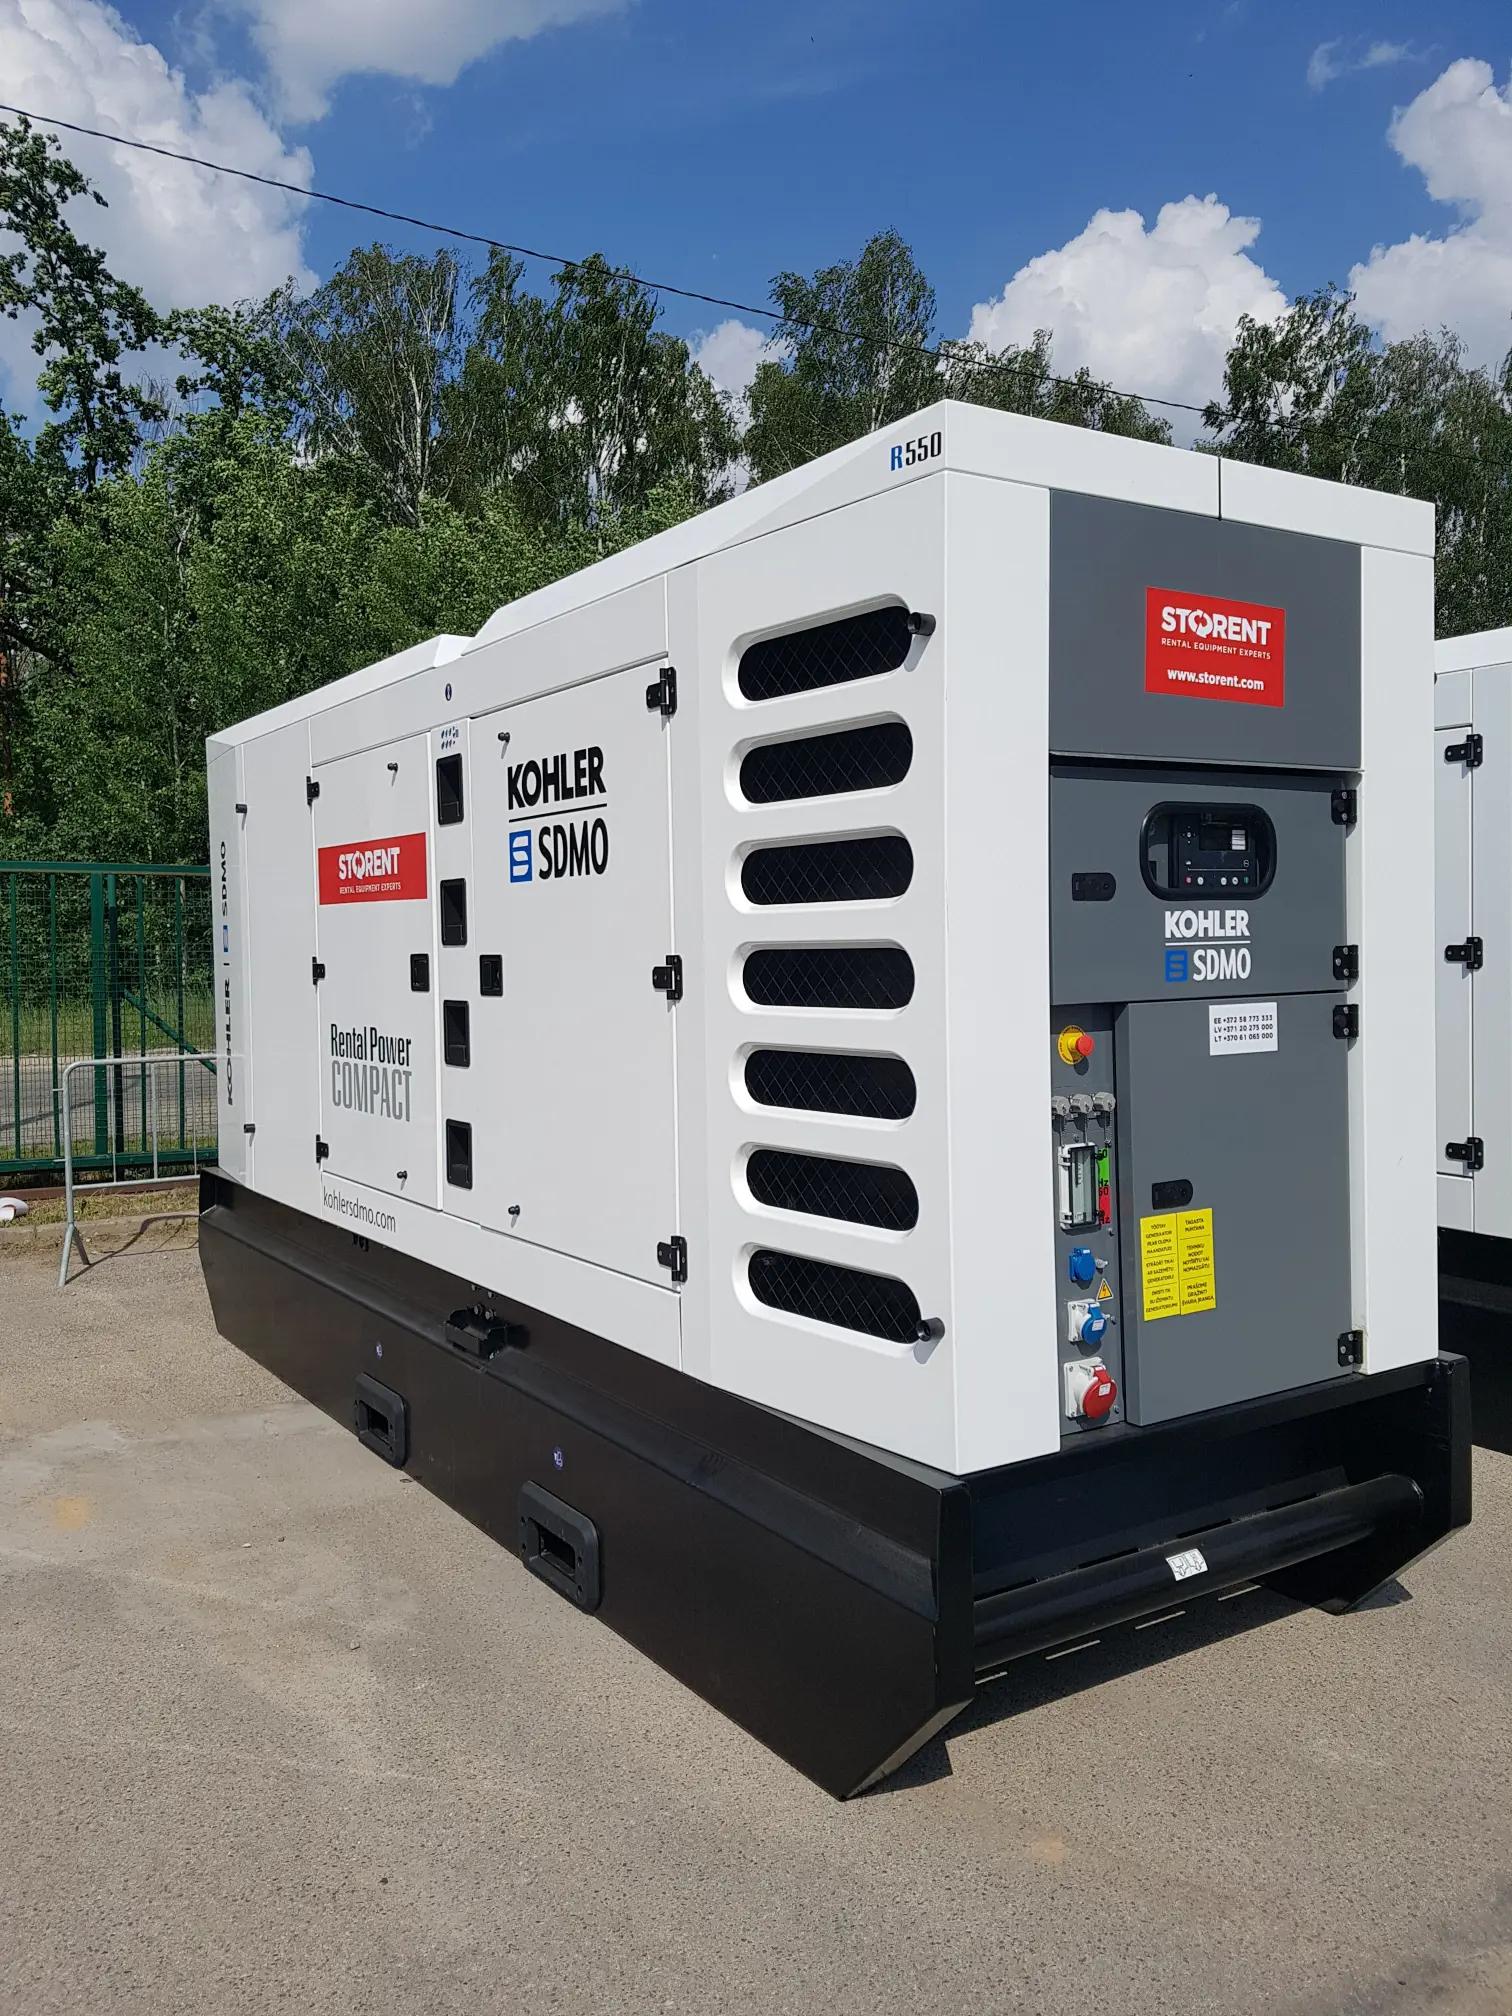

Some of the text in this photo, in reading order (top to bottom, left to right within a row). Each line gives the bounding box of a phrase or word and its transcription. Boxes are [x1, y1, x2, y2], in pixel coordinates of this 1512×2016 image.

[1160, 605, 1272, 646] STORENT
[1161, 637, 1271, 660] RENTAL EQUIPMENT EXPERTS
[1167, 668, 1265, 691] www.storent.com
[507, 745, 607, 811] KOHLER
[338, 846, 401, 880] STORENT
[538, 817, 609, 880] SDMO
[220, 840, 228, 917] SDMO
[339, 881, 402, 895] RENTAL EQUIPMENT EXPERTS
[1164, 909, 1251, 939] KOHLER
[1192, 947, 1252, 982] SDMO
[1213, 1017, 1222, 1025] EE
[1214, 1026, 1222, 1034] LV
[224, 977, 233, 1106] KOHLER
[330, 1023, 412, 1067] Rental Power
[1214, 1035, 1222, 1043] LT
[331, 1059, 413, 1123] COMPACT
[323, 1185, 397, 1234] kohlersdmo.com
